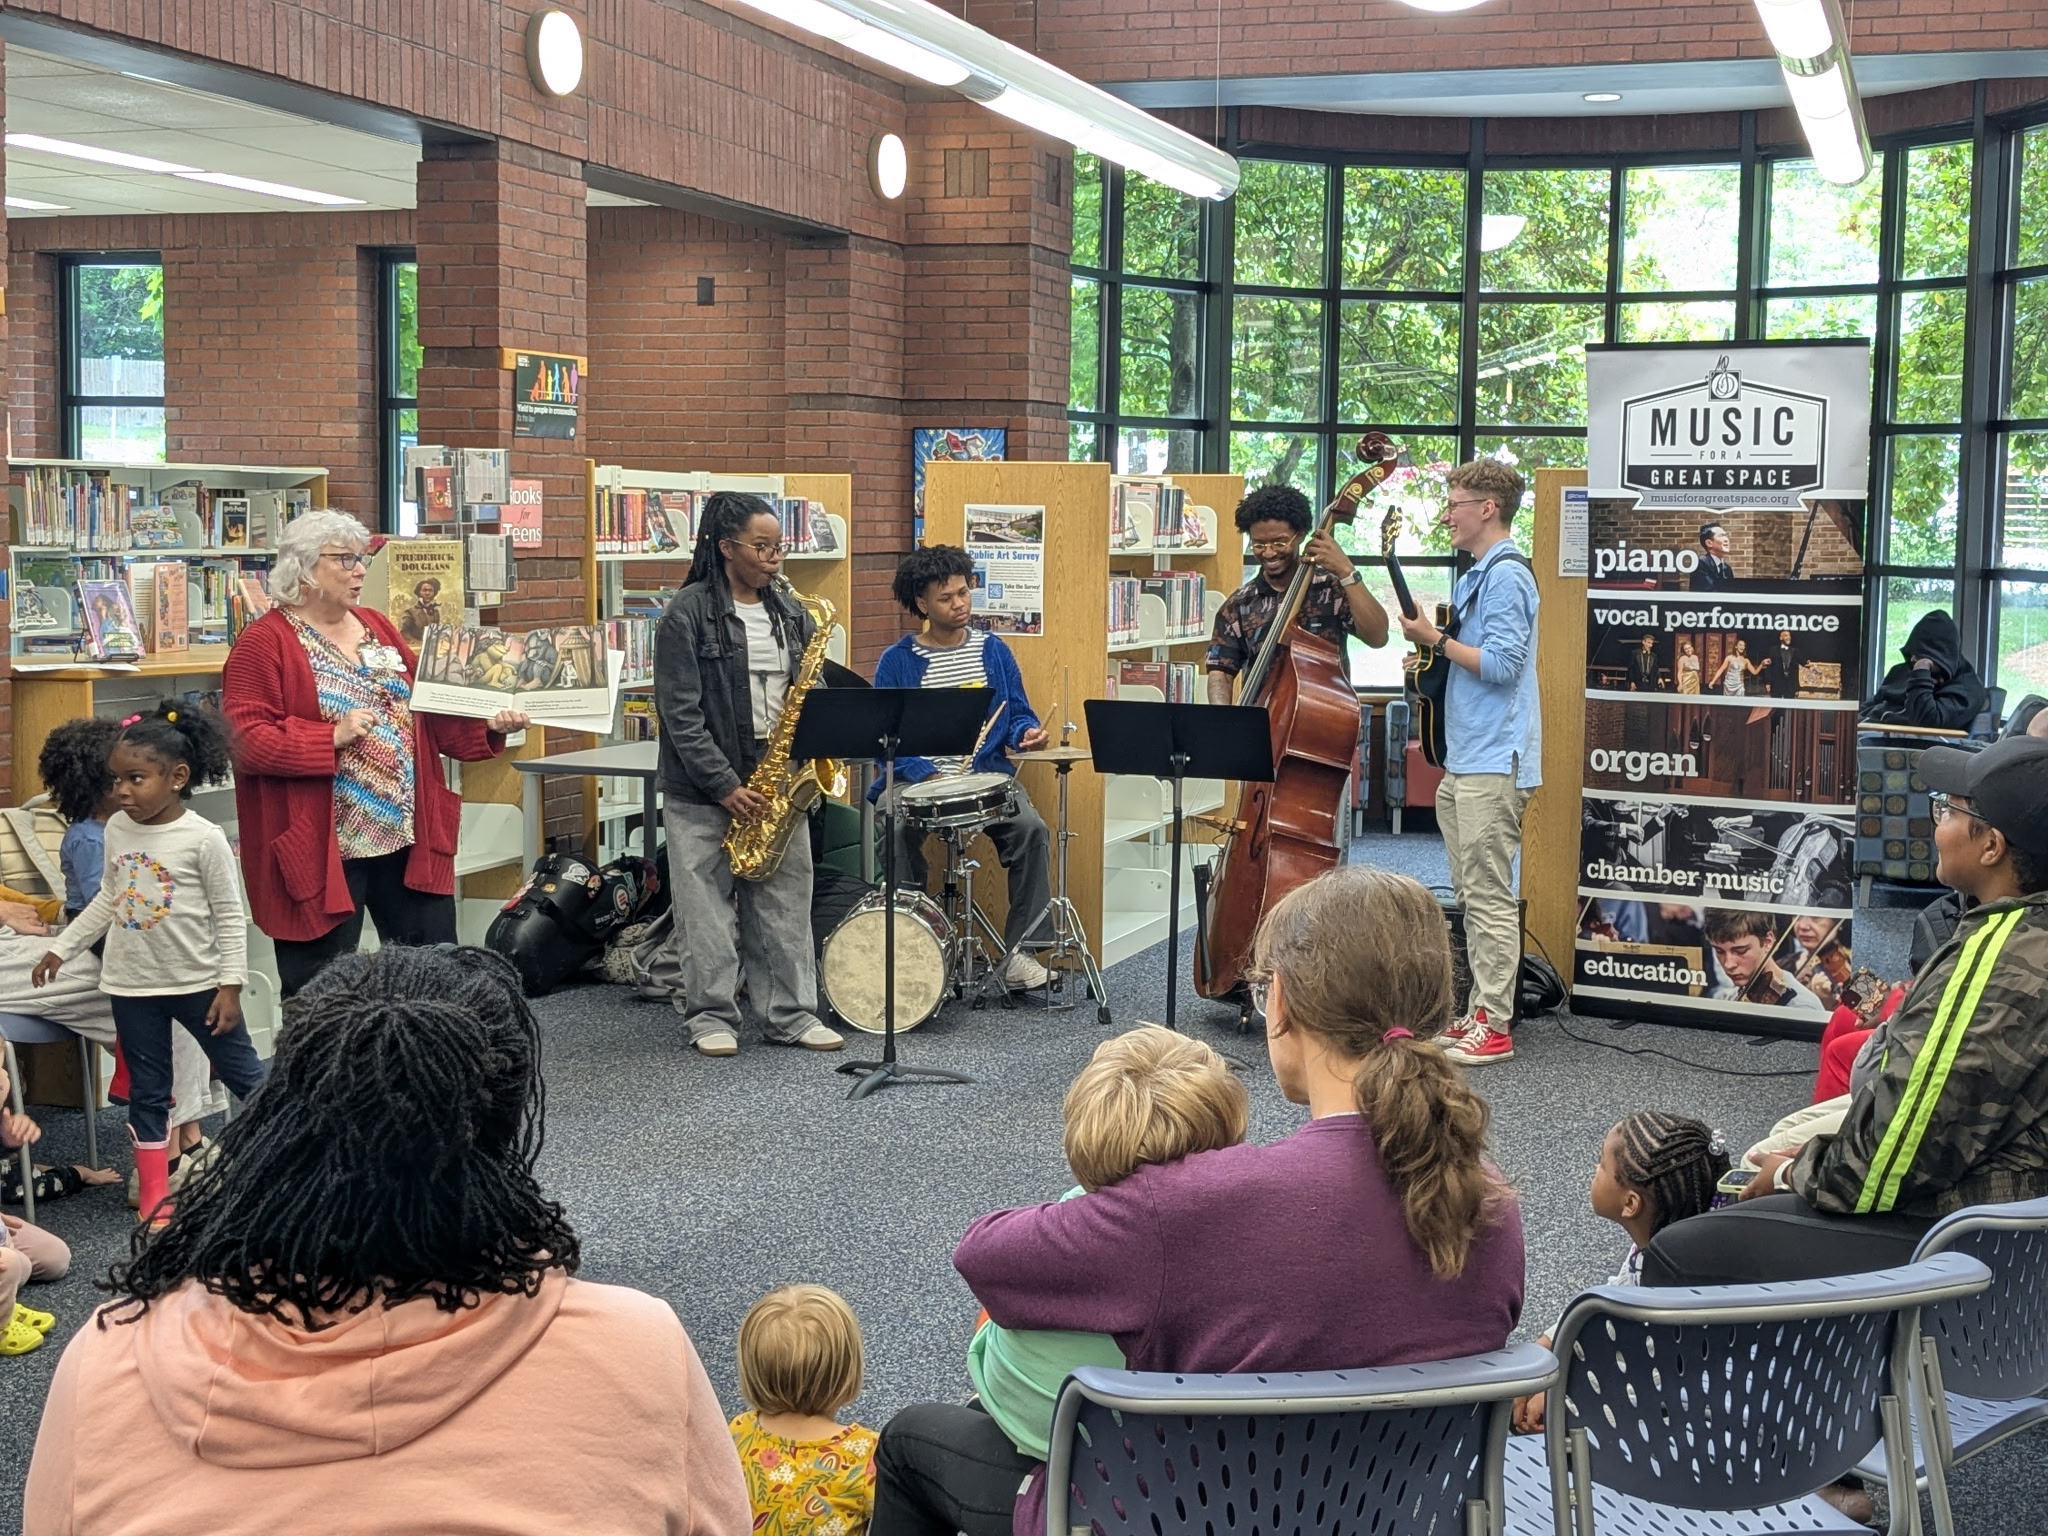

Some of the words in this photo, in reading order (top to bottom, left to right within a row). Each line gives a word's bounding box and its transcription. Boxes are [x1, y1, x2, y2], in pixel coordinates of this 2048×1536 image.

[1650, 406, 1795, 447] MUSIC
[1699, 450, 1726, 460] FOR
[1736, 450, 1743, 460] A
[1650, 469, 1716, 485] GREAT
[1725, 469, 1791, 486] SPACE
[1650, 492, 1790, 505] musicforagreatspace.org
[502, 523, 542, 542] Teens
[396, 553, 455, 562] FREDERICK
[968, 550, 995, 560] Public
[996, 551, 1009, 560] Art
[1012, 551, 1040, 562] Survey
[1594, 540, 1699, 578] piano
[401, 563, 450, 571] DOUGLASS
[1593, 605, 1659, 627] vocal
[1664, 606, 1840, 632] performance
[1589, 748, 1699, 782] organ
[1586, 858, 1700, 887] chamber
[1705, 872, 1784, 894] music
[1583, 956, 1708, 987] education
